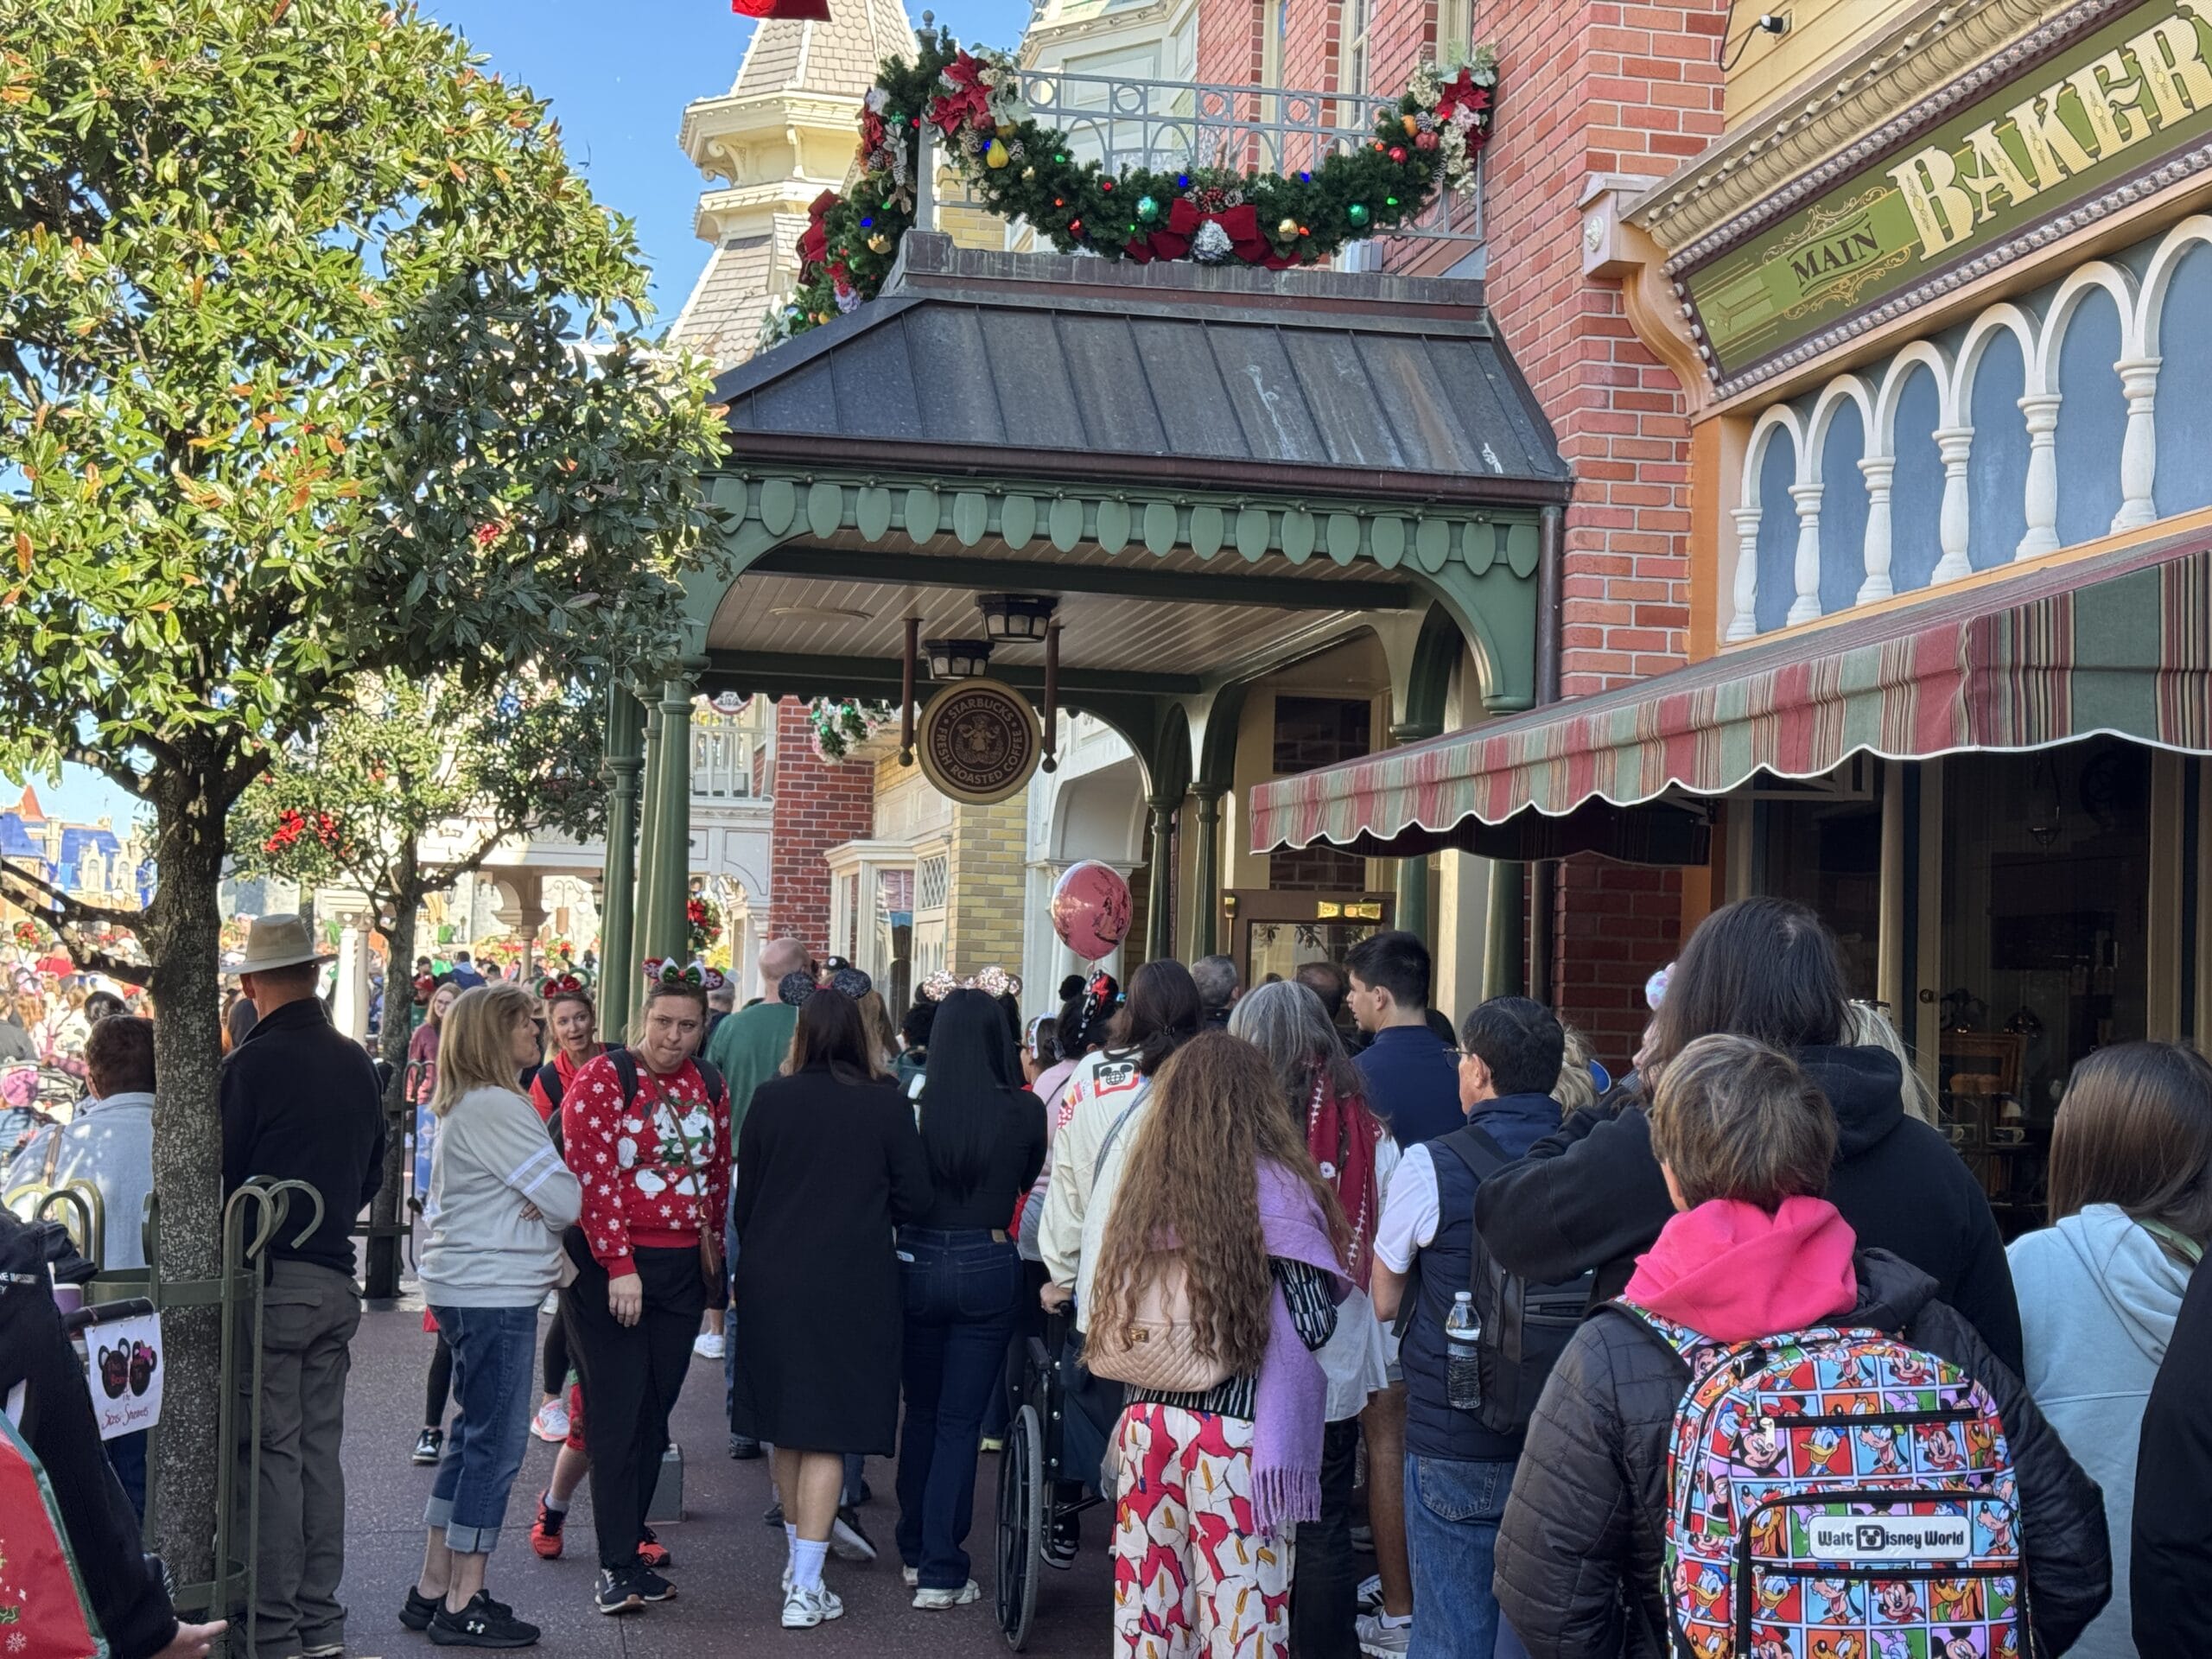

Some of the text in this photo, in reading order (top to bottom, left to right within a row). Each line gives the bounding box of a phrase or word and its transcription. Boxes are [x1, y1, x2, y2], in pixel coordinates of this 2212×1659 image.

[1886, 0, 2212, 262] BAKER
[1791, 223, 1879, 288] MAIN
[948, 697, 1014, 722] STARBUCKS
[936, 727, 1022, 785] FRESH ROASTED COFFEE
[1818, 1524, 1964, 1551] Walt Disney World
